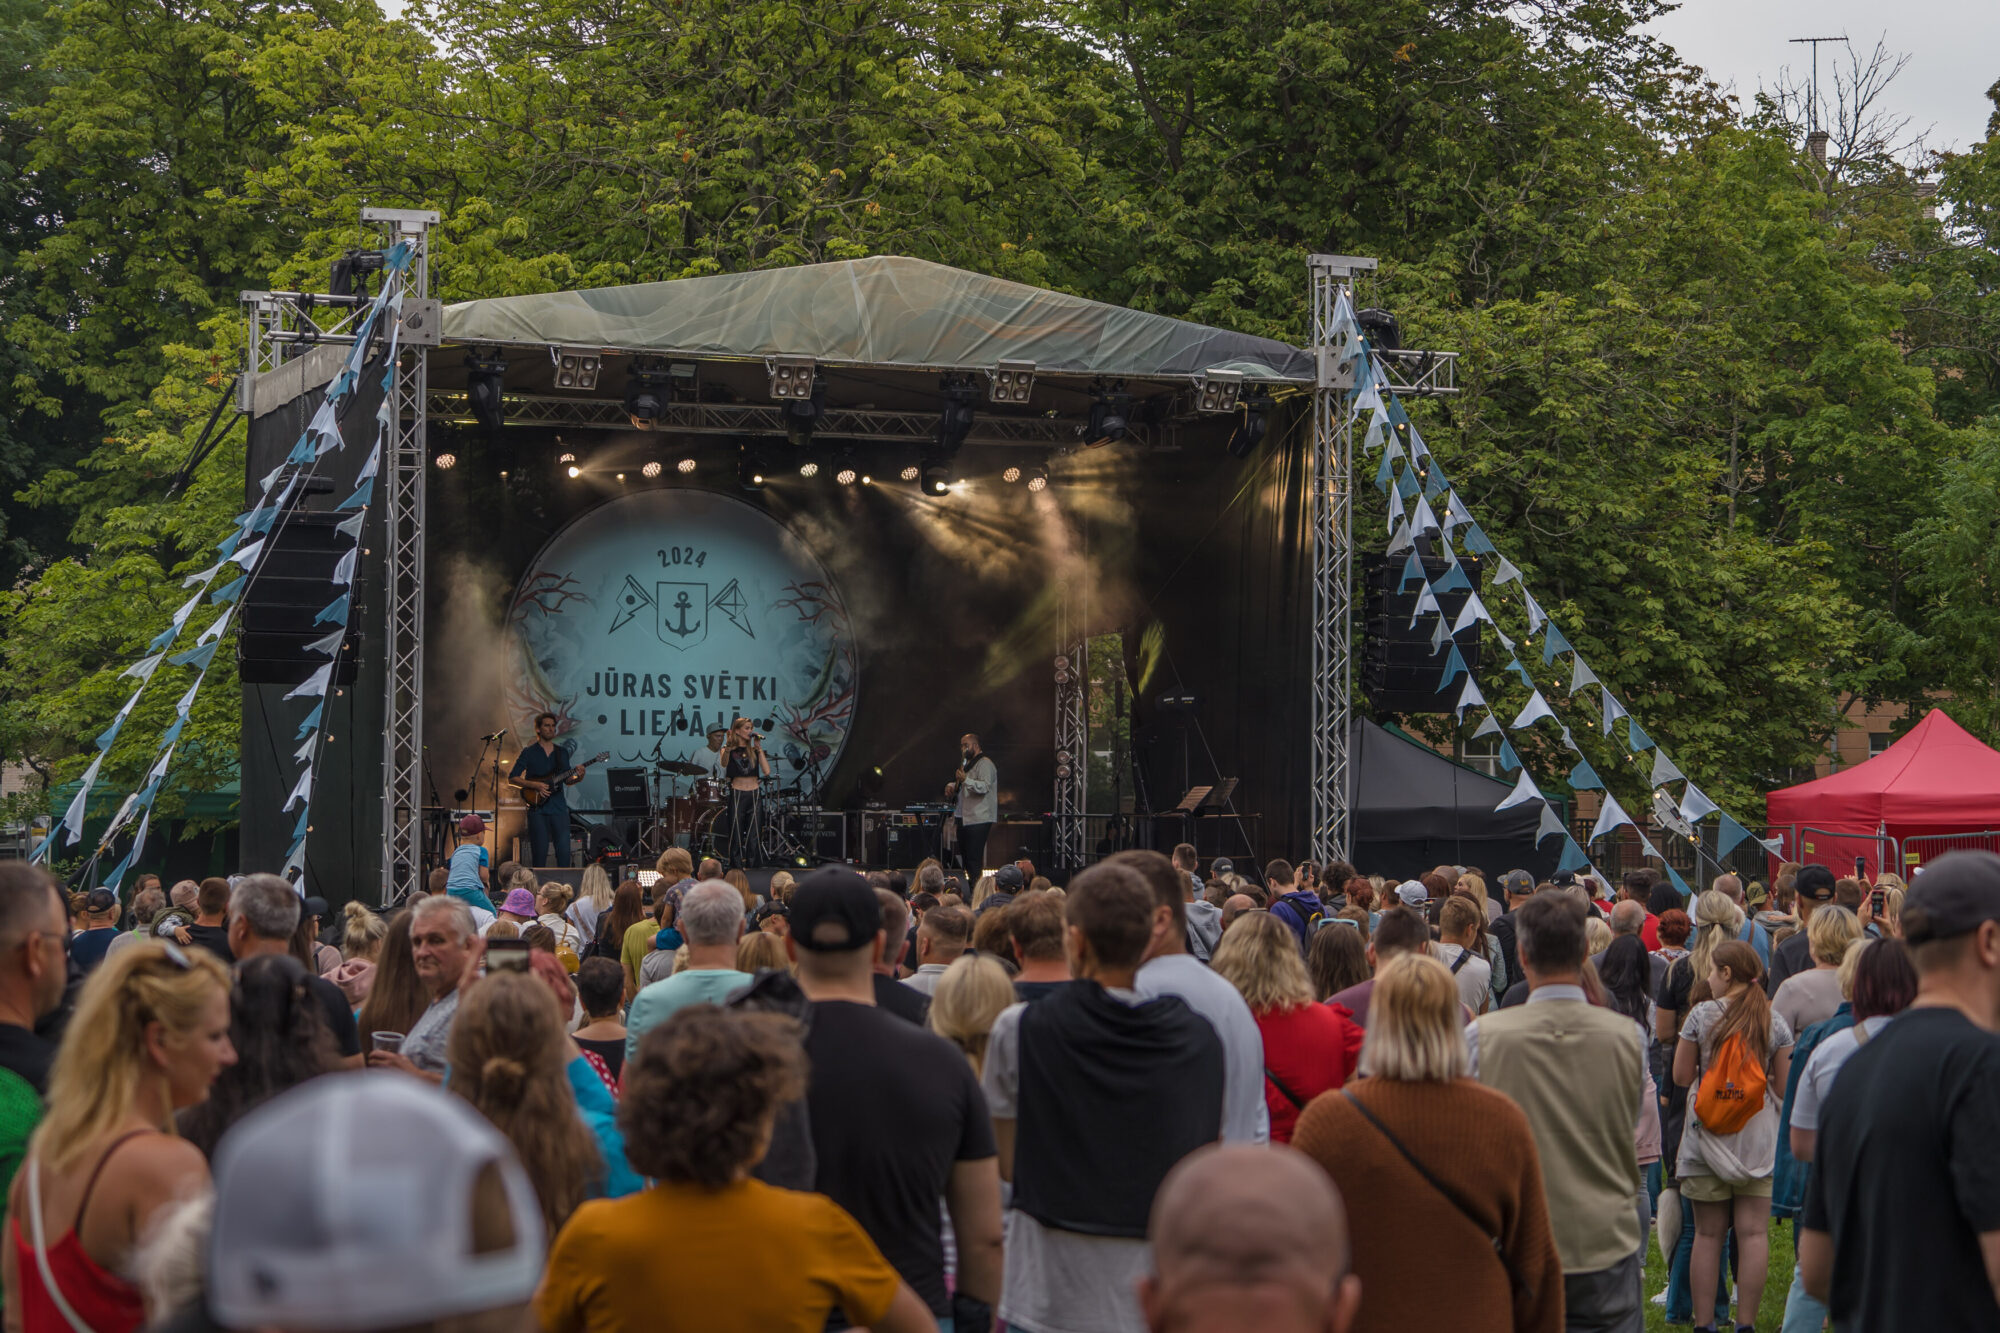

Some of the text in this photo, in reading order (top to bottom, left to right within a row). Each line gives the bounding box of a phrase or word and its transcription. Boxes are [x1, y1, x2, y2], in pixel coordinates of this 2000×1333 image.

[657, 546, 707, 568] 2024
[586, 666, 777, 701] JŪRAS SVĒTKI
